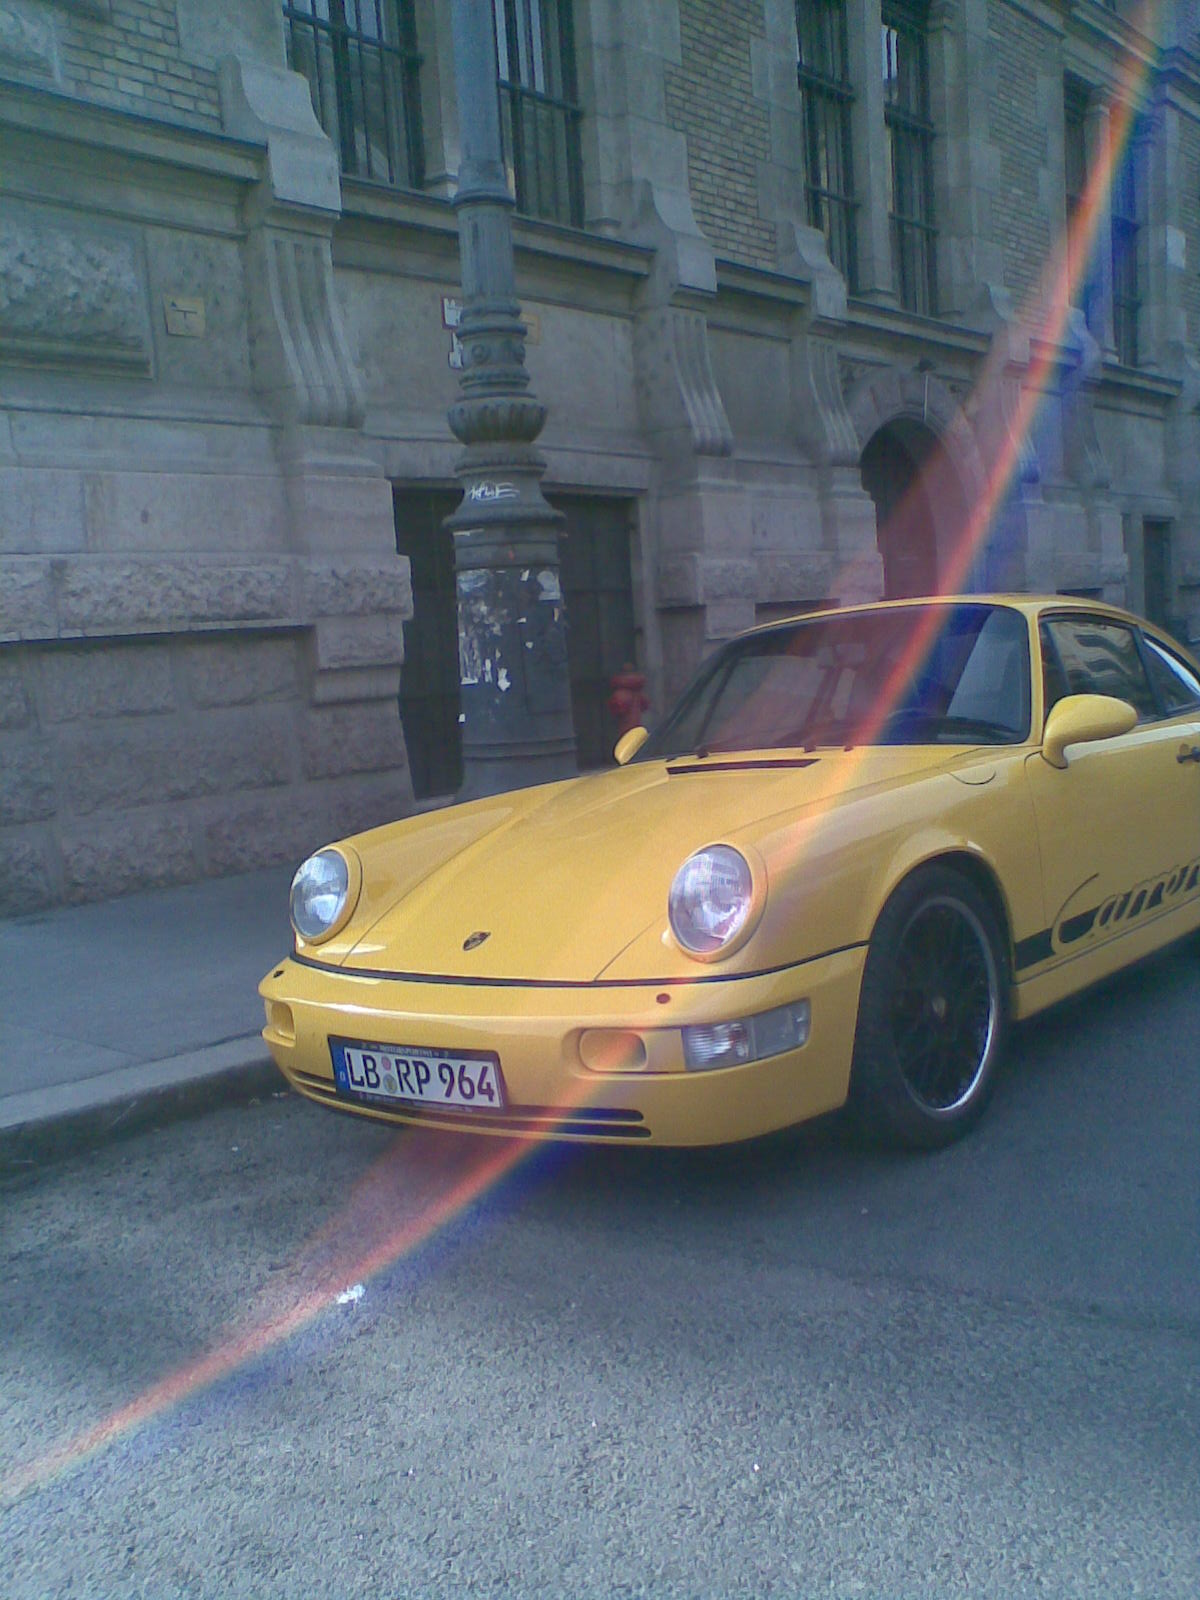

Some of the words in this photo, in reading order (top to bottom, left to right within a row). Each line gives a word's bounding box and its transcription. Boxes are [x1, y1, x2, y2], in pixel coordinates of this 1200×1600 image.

[346, 1051, 381, 1089] LB
[394, 1058, 431, 1096] RP
[437, 1062, 495, 1102] 964
